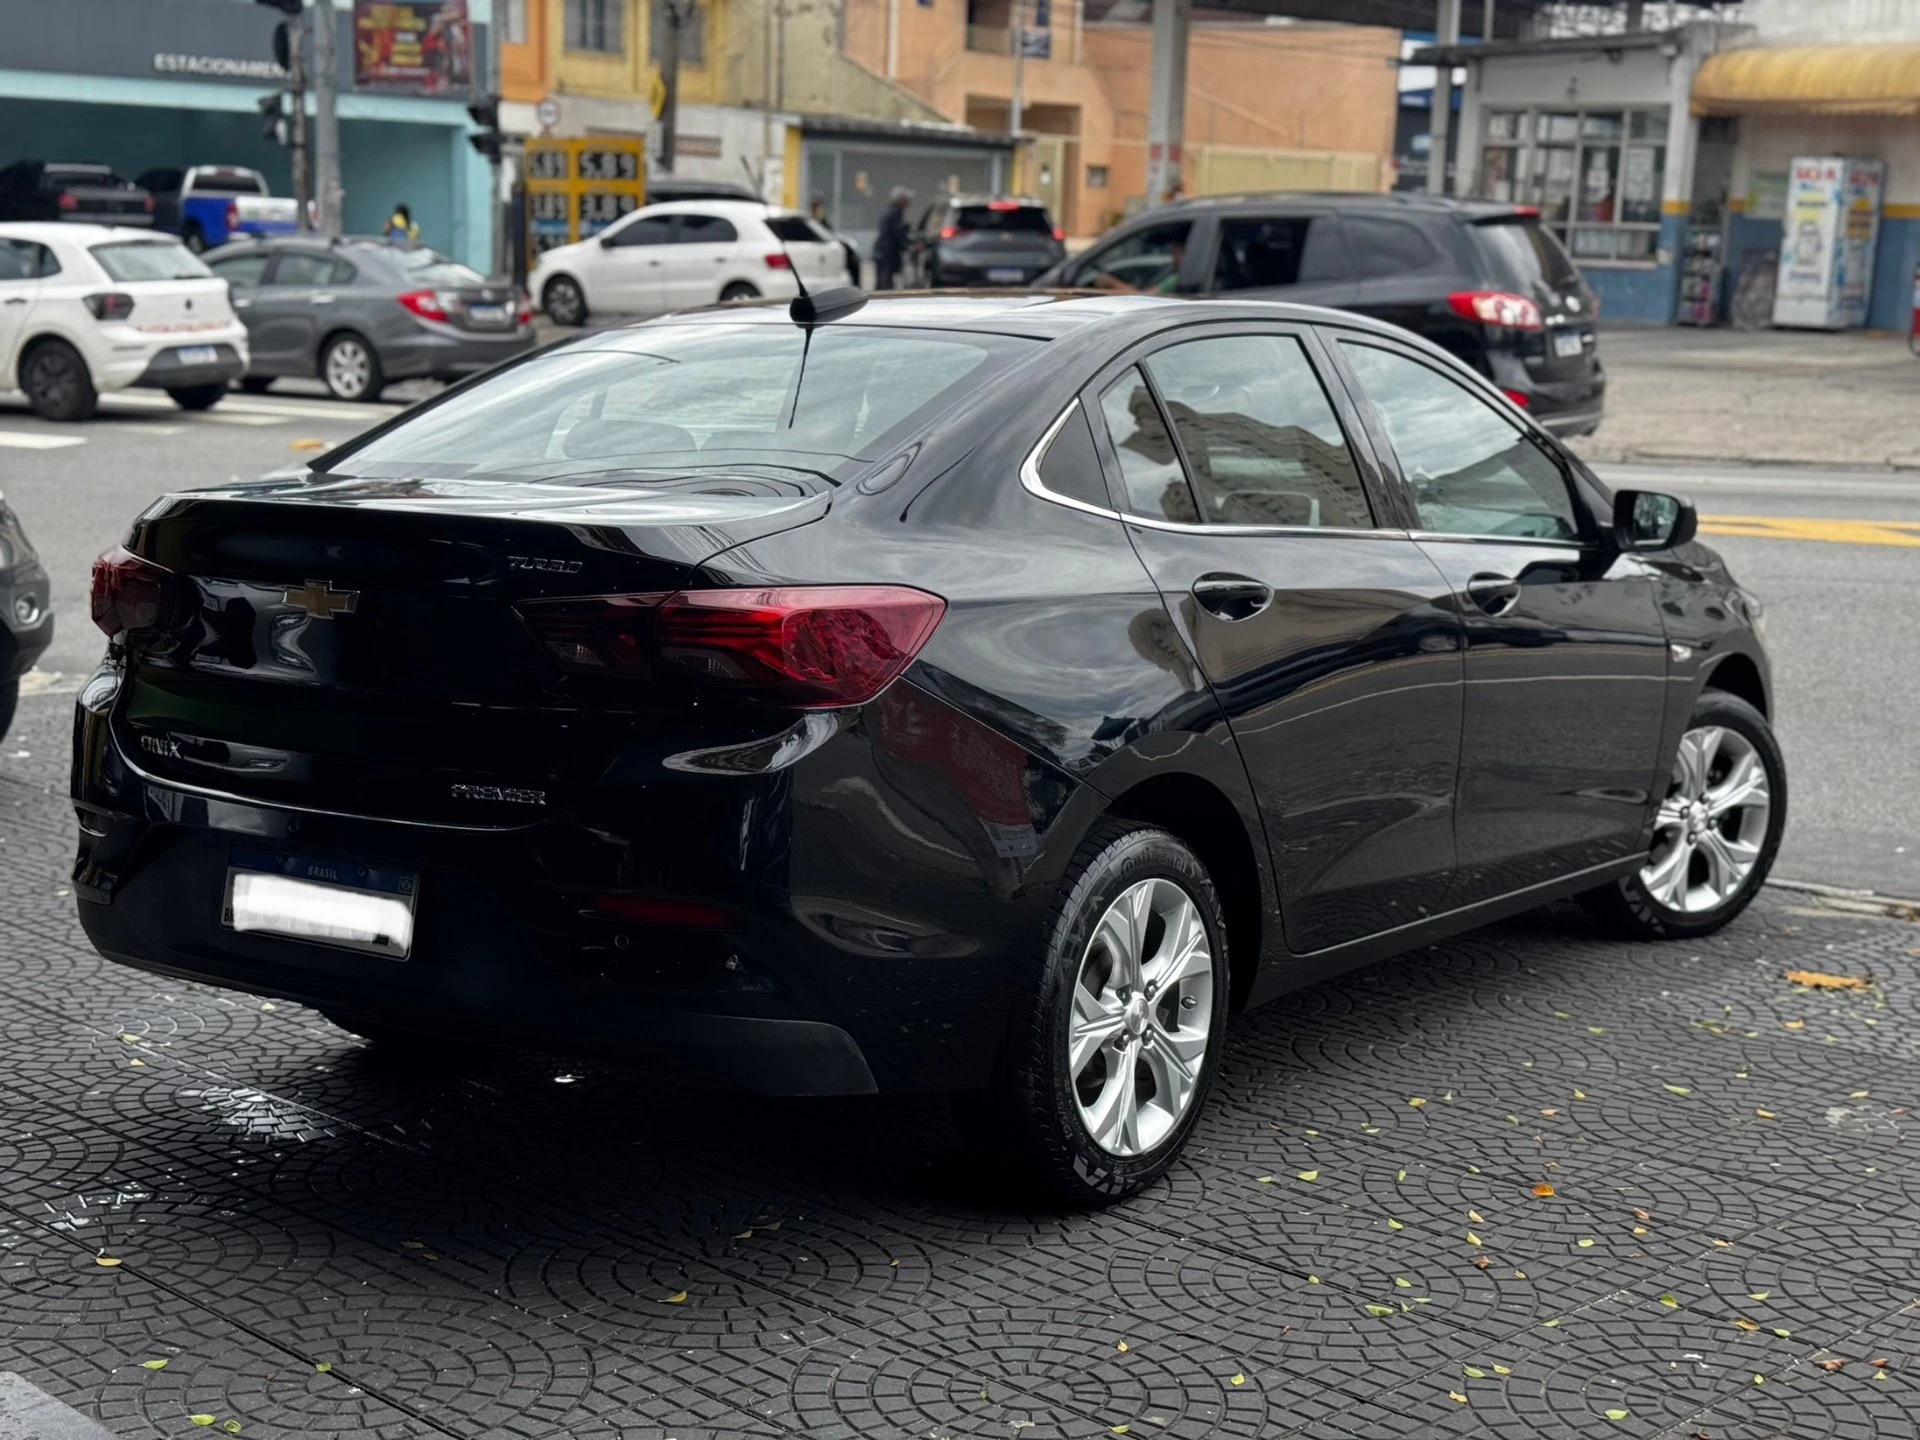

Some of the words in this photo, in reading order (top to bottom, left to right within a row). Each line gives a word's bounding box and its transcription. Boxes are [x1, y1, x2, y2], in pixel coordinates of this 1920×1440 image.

[154, 53, 292, 80] ESTACIONAMEN
[508, 555, 583, 574] TURBO
[141, 735, 182, 759] ONIX
[451, 784, 546, 805] PREMIER
[308, 865, 339, 880] BRASIL
